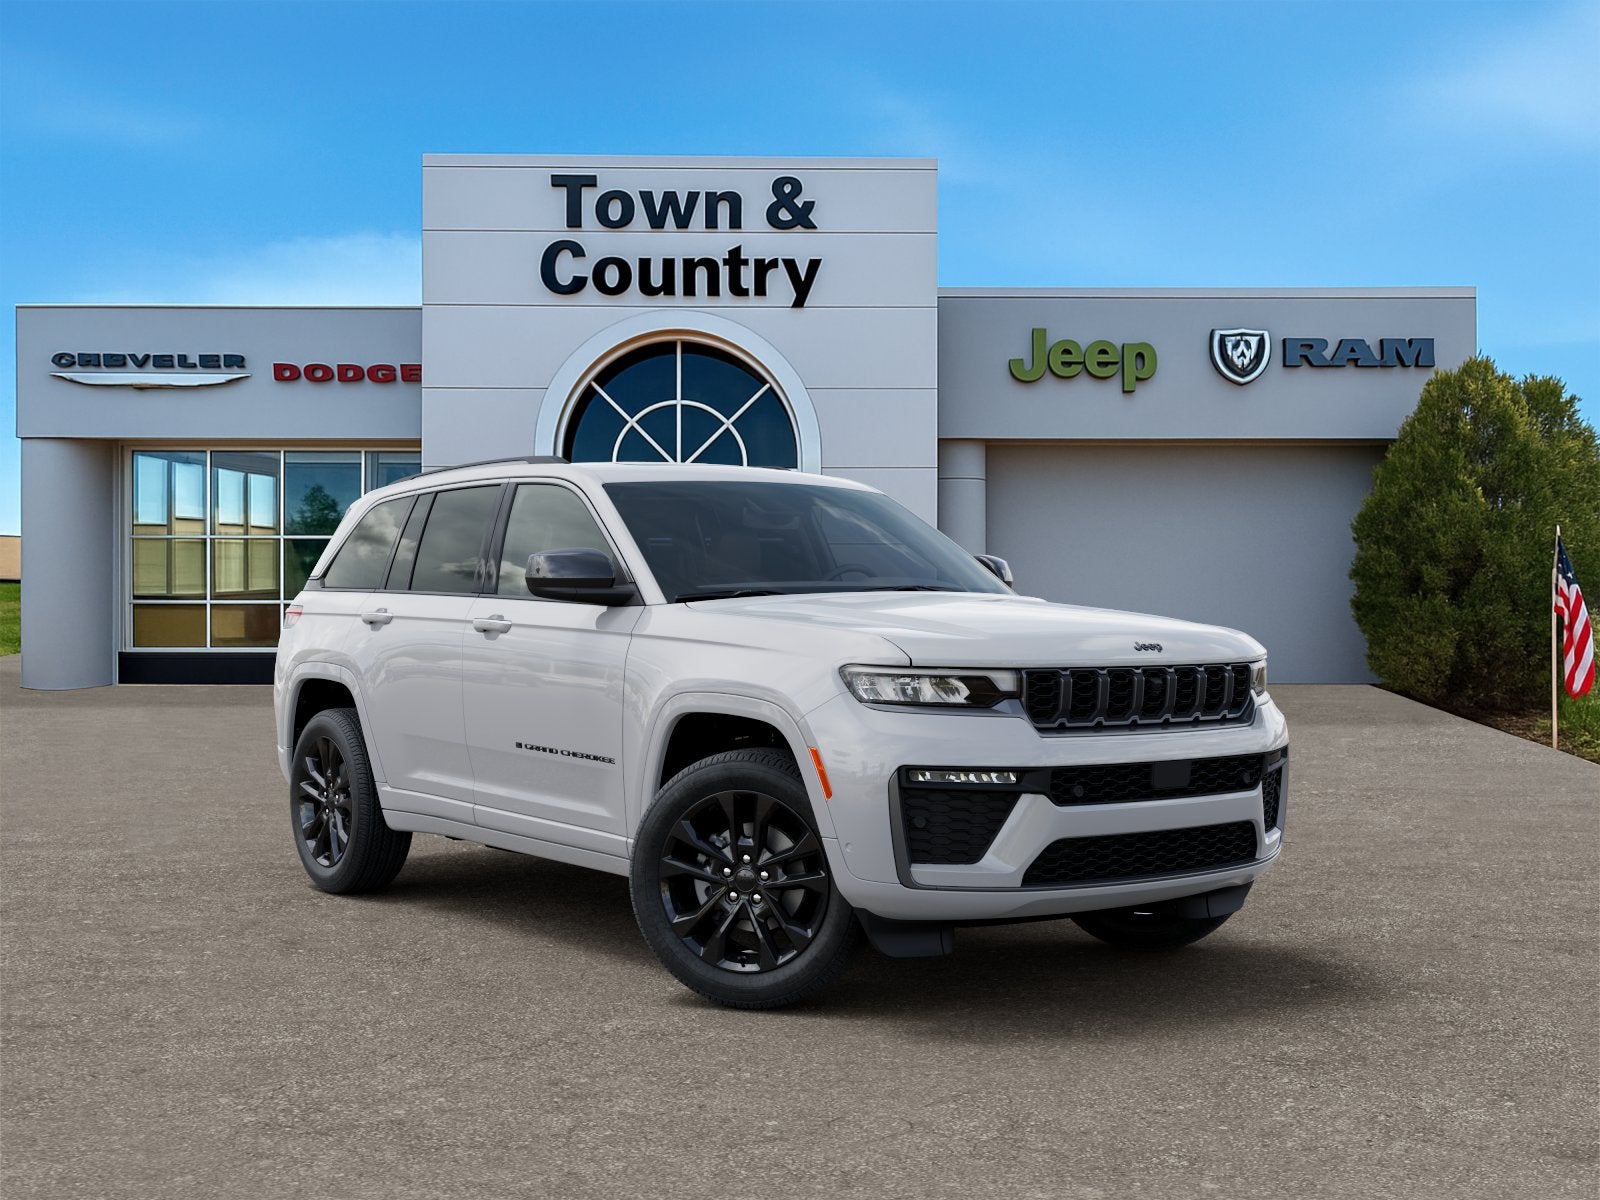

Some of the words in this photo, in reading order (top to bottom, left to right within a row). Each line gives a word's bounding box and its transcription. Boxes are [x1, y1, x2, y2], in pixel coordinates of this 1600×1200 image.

[550, 174, 742, 229] Town
[766, 176, 818, 230] &
[540, 239, 823, 308] Country
[1008, 327, 1158, 393] Jeep
[1282, 337, 1436, 368] RAM
[272, 363, 422, 383] DODGE
[1134, 641, 1163, 653] Jeep
[524, 743, 558, 754] GRAND
[560, 749, 615, 764] CHEROKEE
